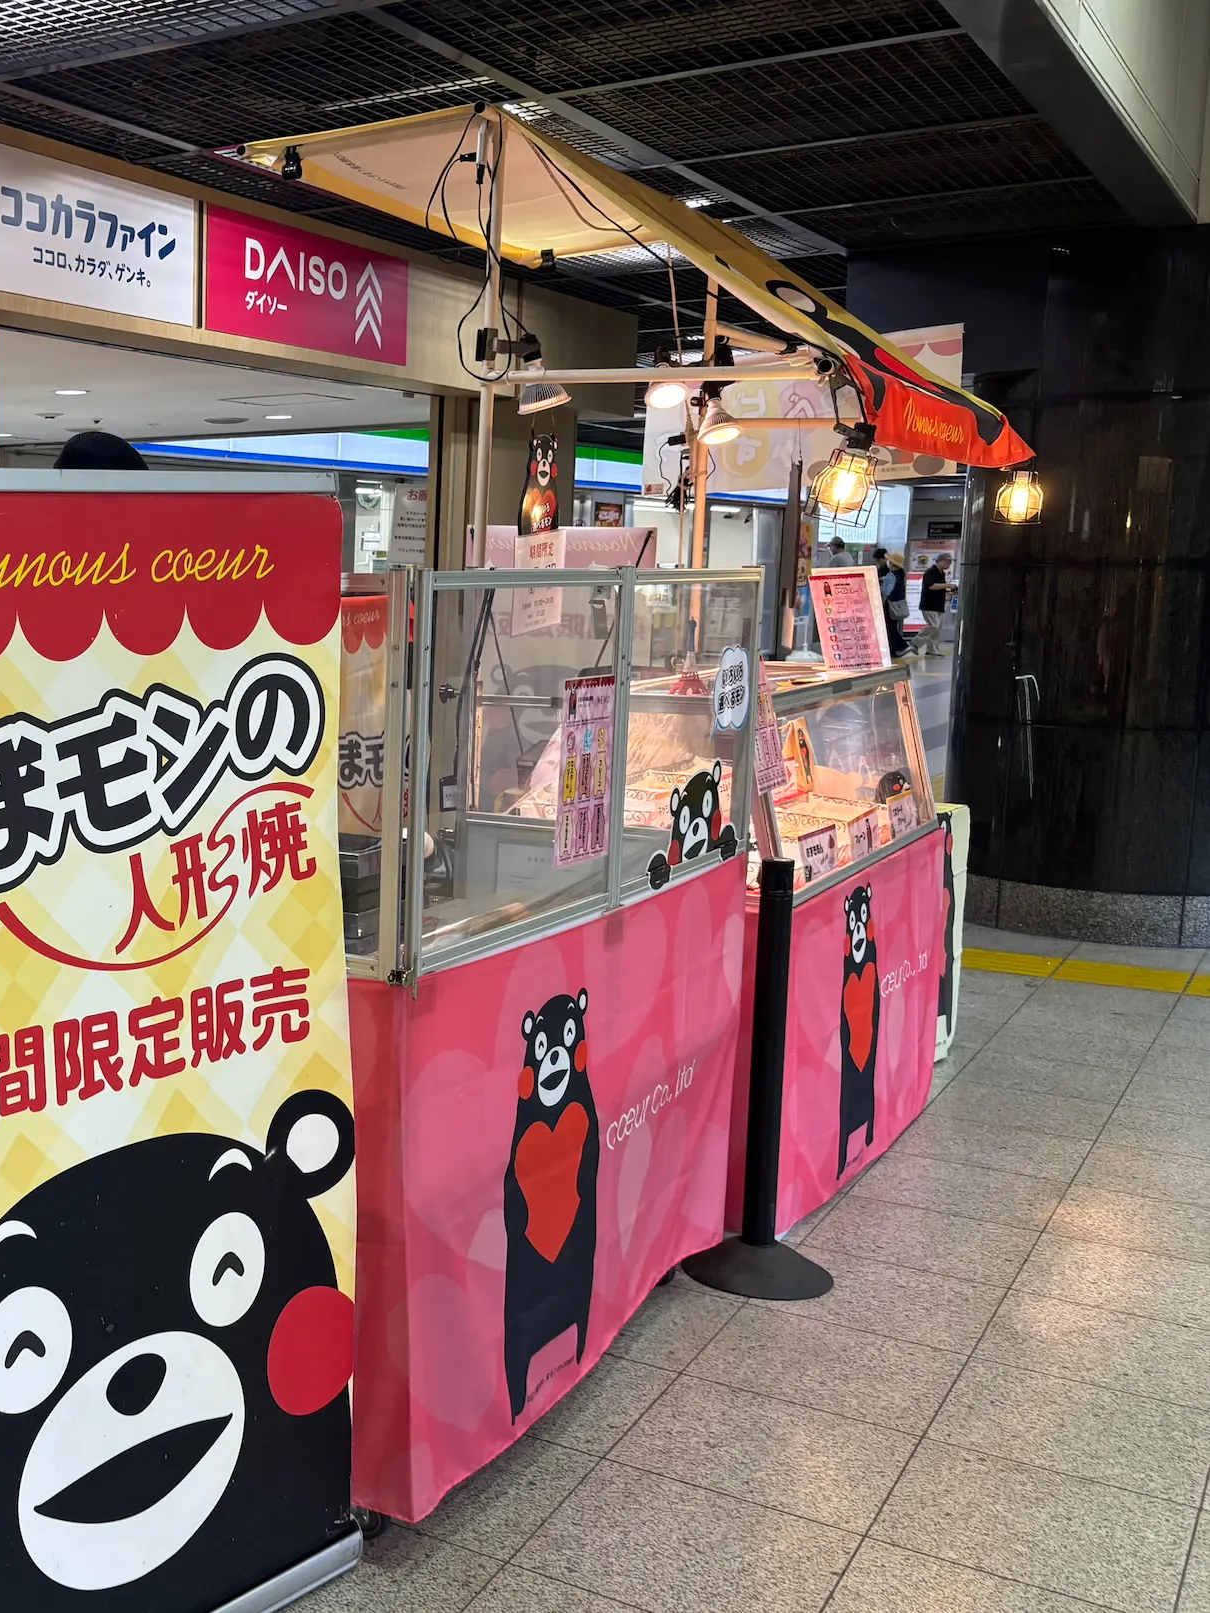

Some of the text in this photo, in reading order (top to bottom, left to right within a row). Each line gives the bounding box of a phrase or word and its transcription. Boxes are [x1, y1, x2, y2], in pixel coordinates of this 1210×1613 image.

[0, 186, 176, 260] ココカラファイン
[32, 246, 152, 288] ココロ、カラダ、ゲンキ。
[245, 237, 348, 300] DAISO
[244, 290, 288, 315] ダイソー
[150, 543, 275, 583] coeur
[115, 800, 318, 955] 人形焼
